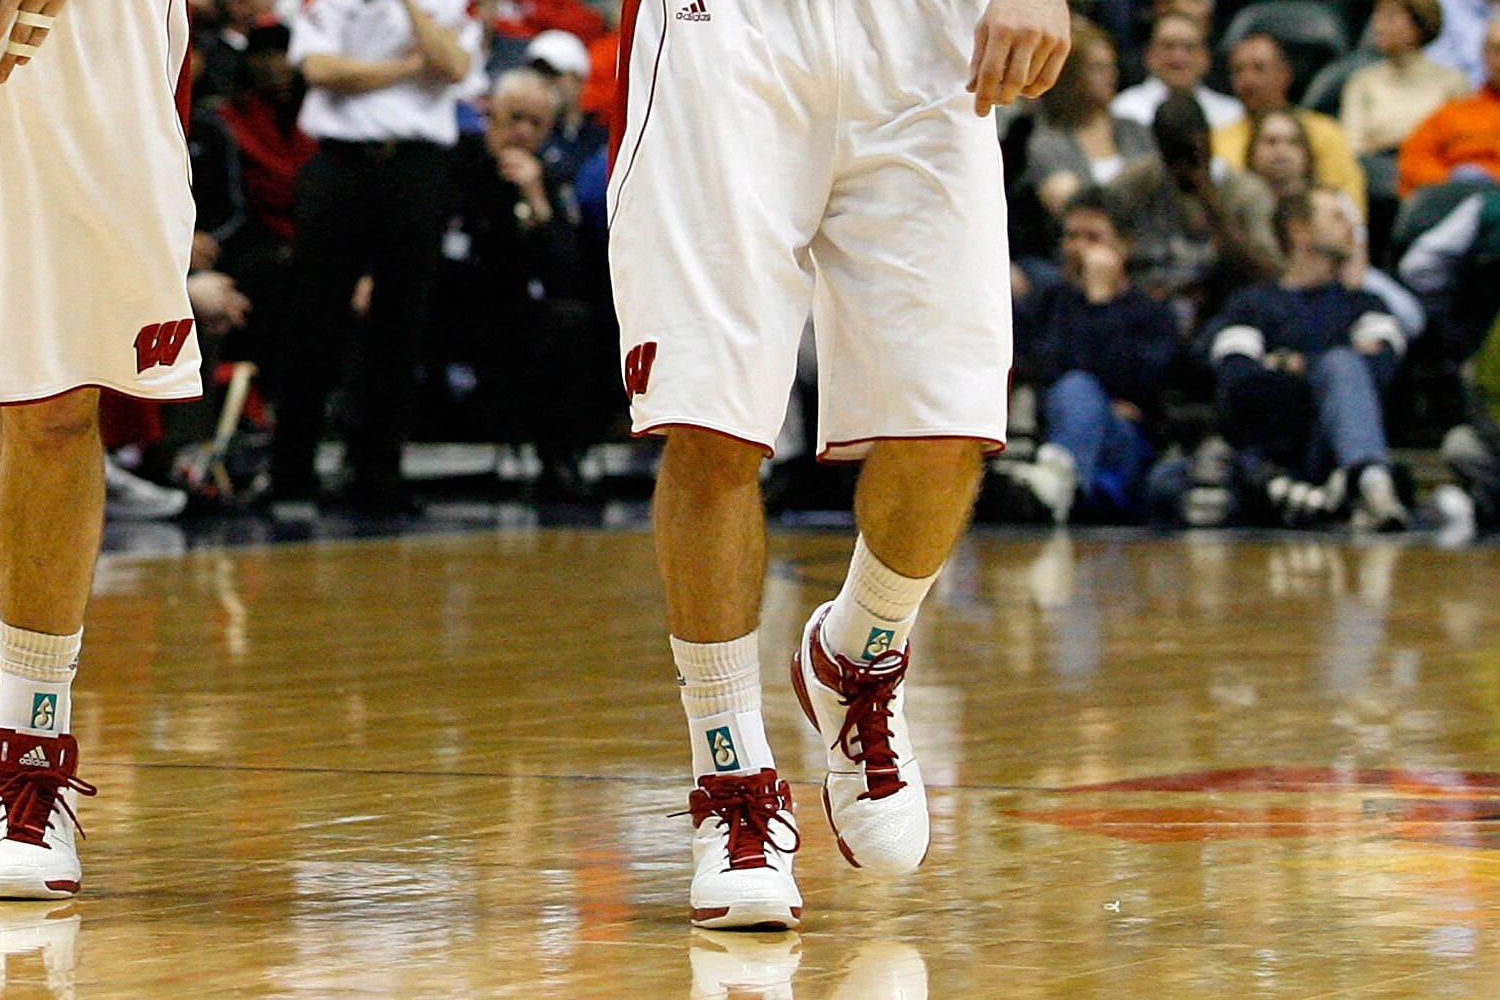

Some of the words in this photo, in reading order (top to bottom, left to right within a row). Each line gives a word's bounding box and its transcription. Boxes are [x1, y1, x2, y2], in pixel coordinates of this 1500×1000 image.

[676, 10, 711, 22] adidas
[133, 318, 195, 375] W
[19, 756, 51, 768] adidas
